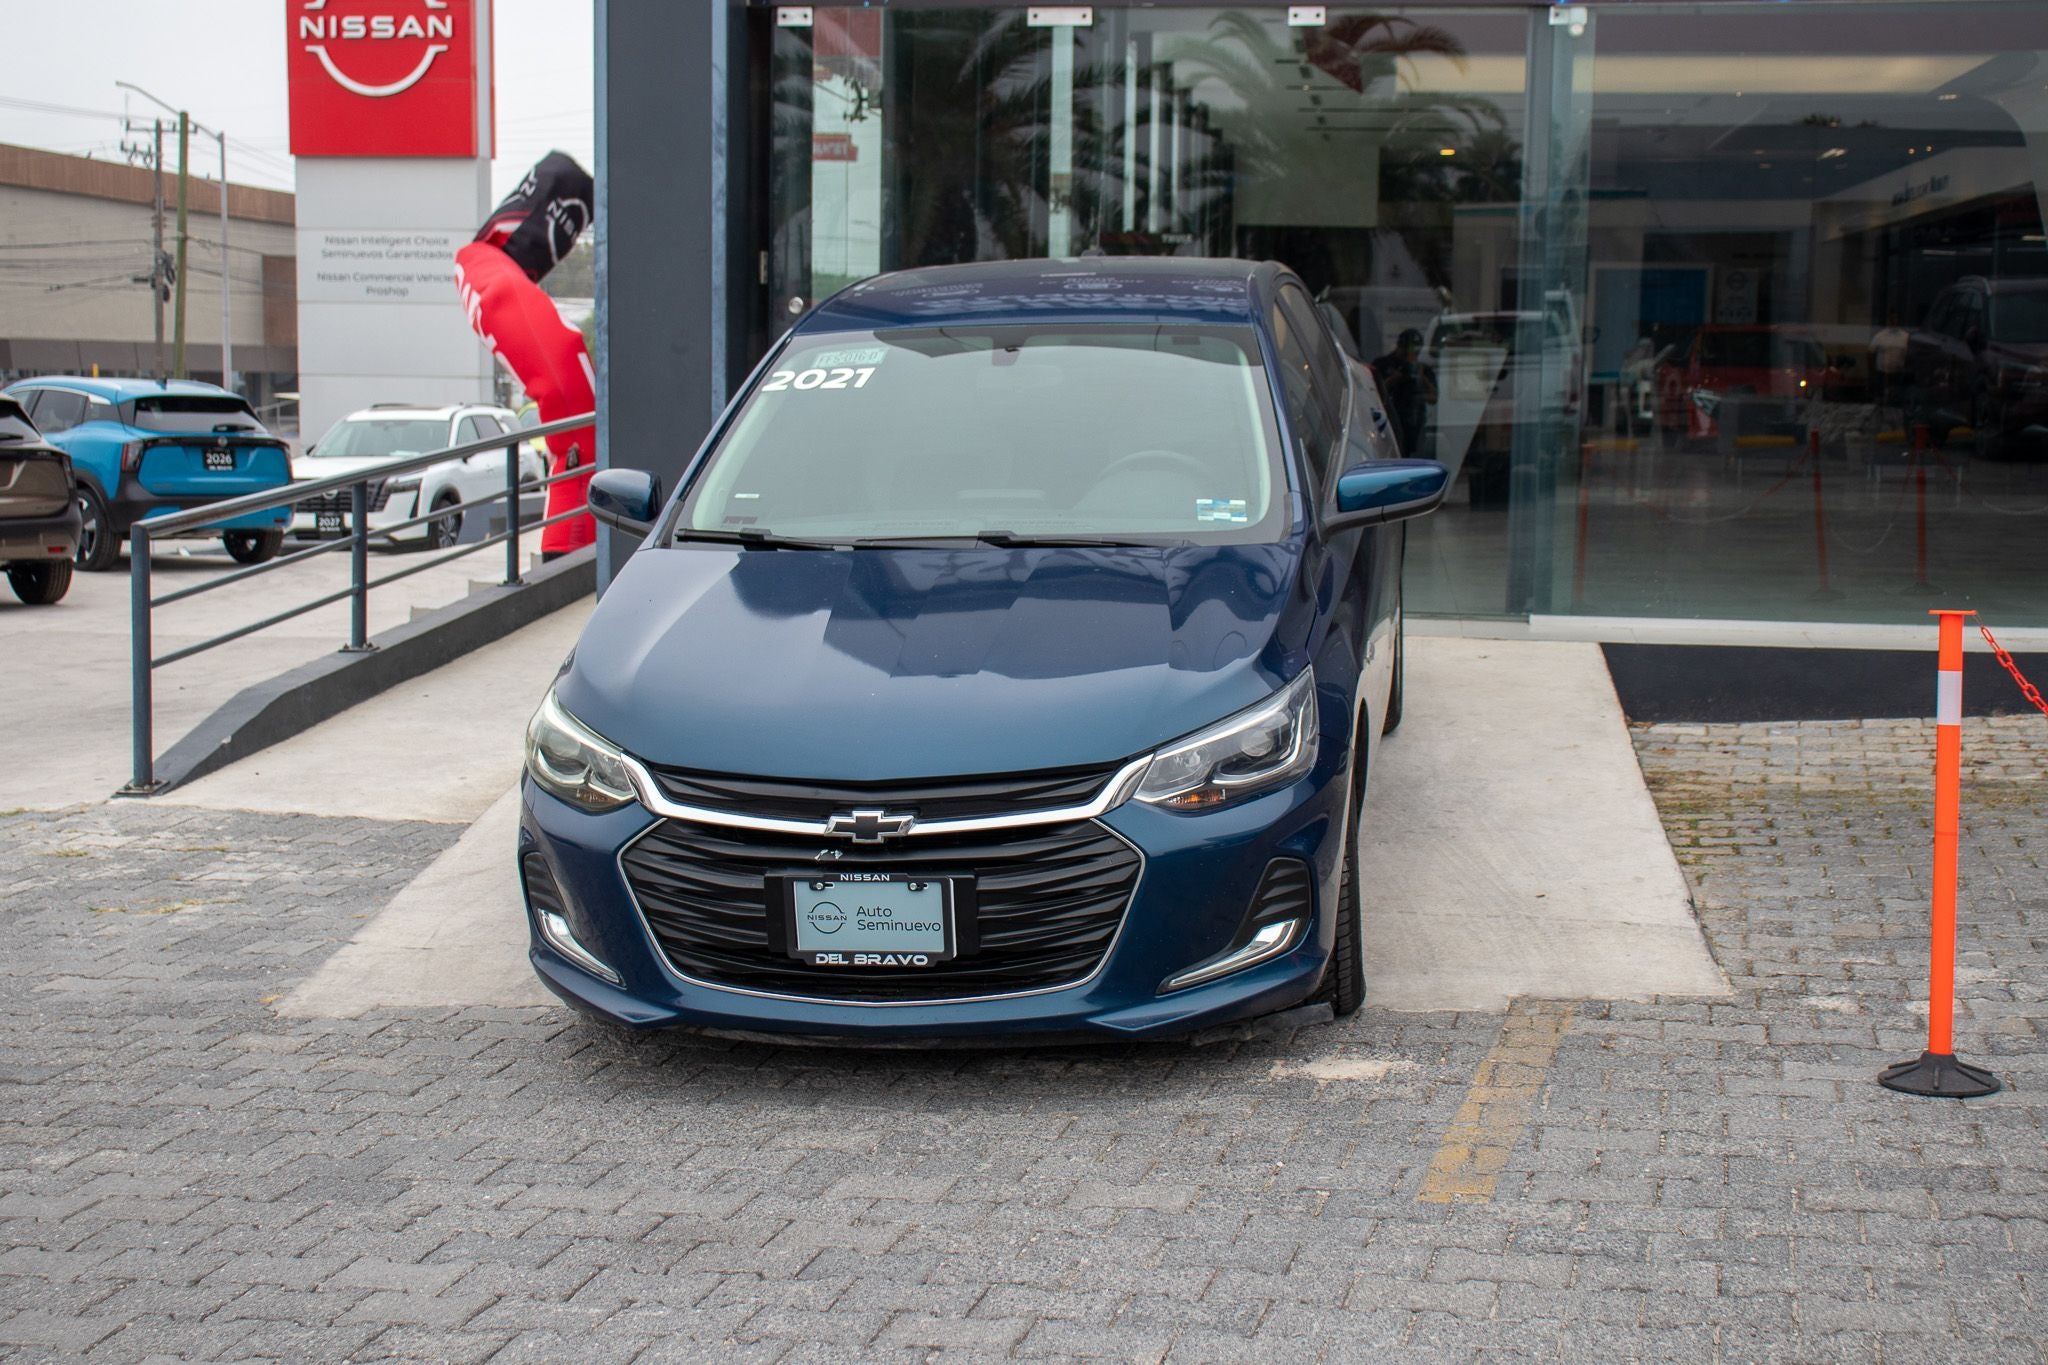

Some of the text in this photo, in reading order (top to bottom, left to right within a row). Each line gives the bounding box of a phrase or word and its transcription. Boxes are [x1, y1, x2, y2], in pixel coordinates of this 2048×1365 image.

[300, 15, 453, 39] NISSAN
[325, 235, 359, 245] Nissan
[413, 235, 449, 245] Choice
[321, 249, 453, 260] Seminuevos Garantizados
[317, 272, 351, 282] Nissan
[352, 272, 414, 282] Commercial
[366, 285, 409, 297] Proshop
[762, 367, 876, 392] 2021
[206, 453, 233, 465] 2026
[319, 517, 341, 528] 2027
[840, 873, 890, 882] NISSAN
[856, 905, 893, 918] Auto
[857, 919, 942, 932] Seminuevo
[815, 953, 929, 966] DEL BRAVO
